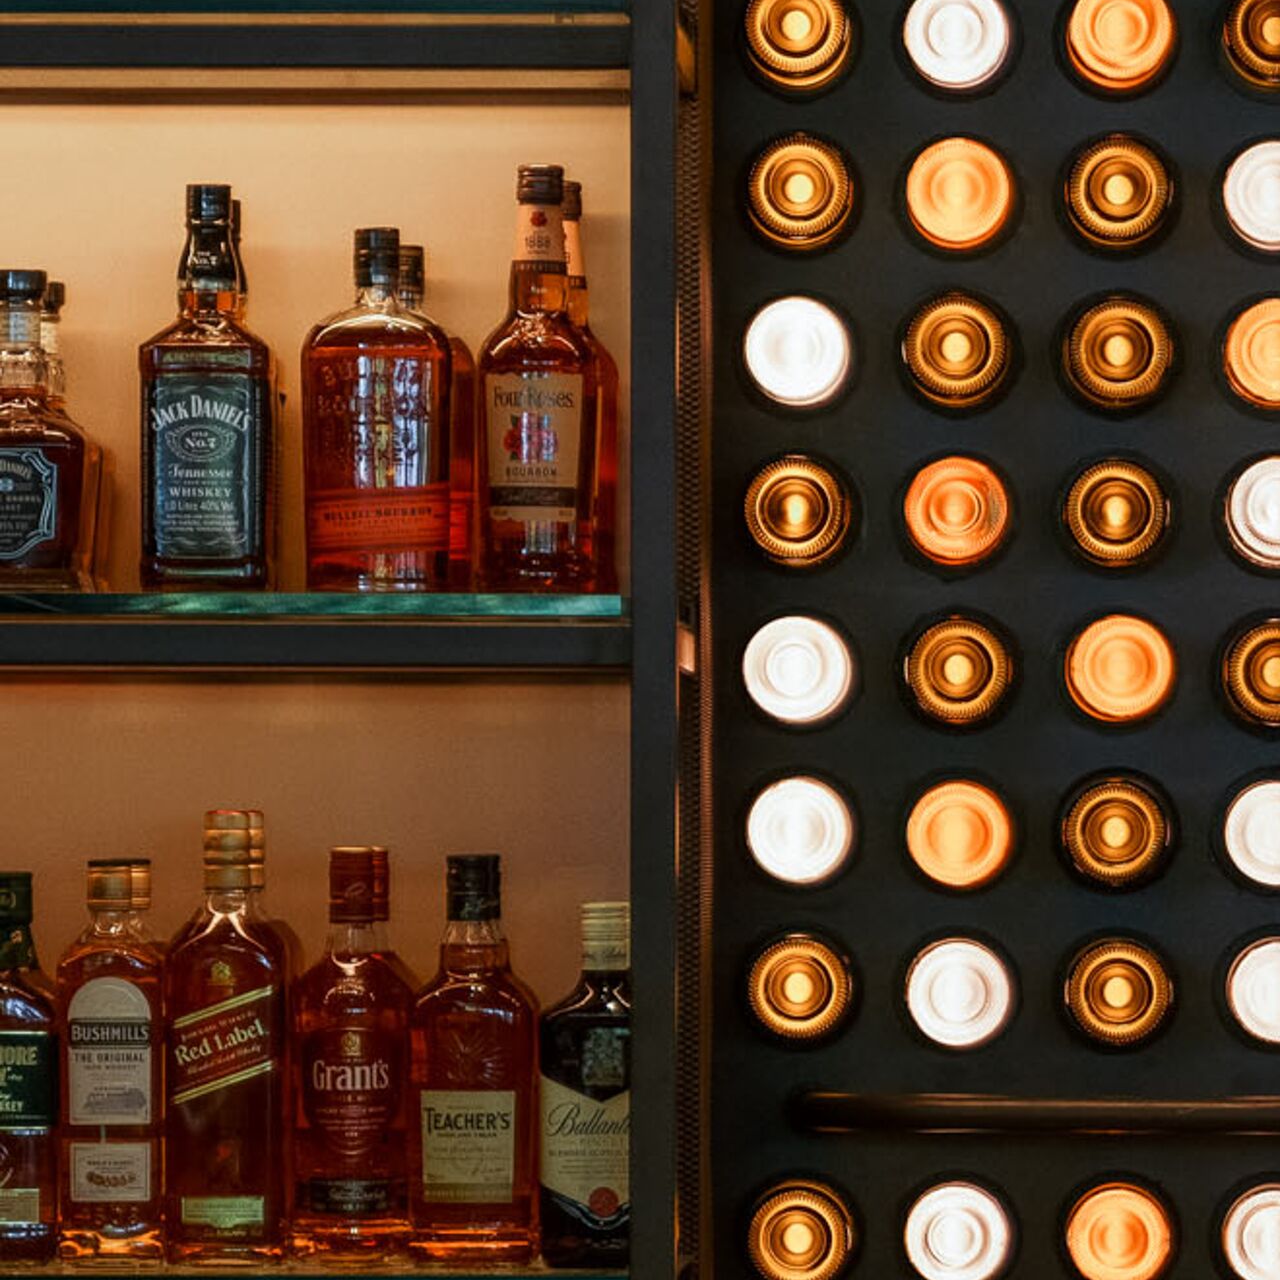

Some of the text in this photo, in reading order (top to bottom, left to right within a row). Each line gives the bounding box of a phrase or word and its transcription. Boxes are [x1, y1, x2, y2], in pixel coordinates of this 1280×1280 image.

[494, 386, 521, 408] Four
[151, 394, 252, 431] JACK DANIEL'S
[168, 463, 233, 478] Tennessee
[169, 487, 232, 497] WHISKEY
[71, 1025, 149, 1041] BUSHMILLS
[175, 1037, 213, 1066] Red
[214, 1018, 264, 1051] Label
[74, 1052, 145, 1063] THE ORIGINAL
[313, 1058, 390, 1091] Grant's
[423, 1107, 511, 1134] TEACHER'S
